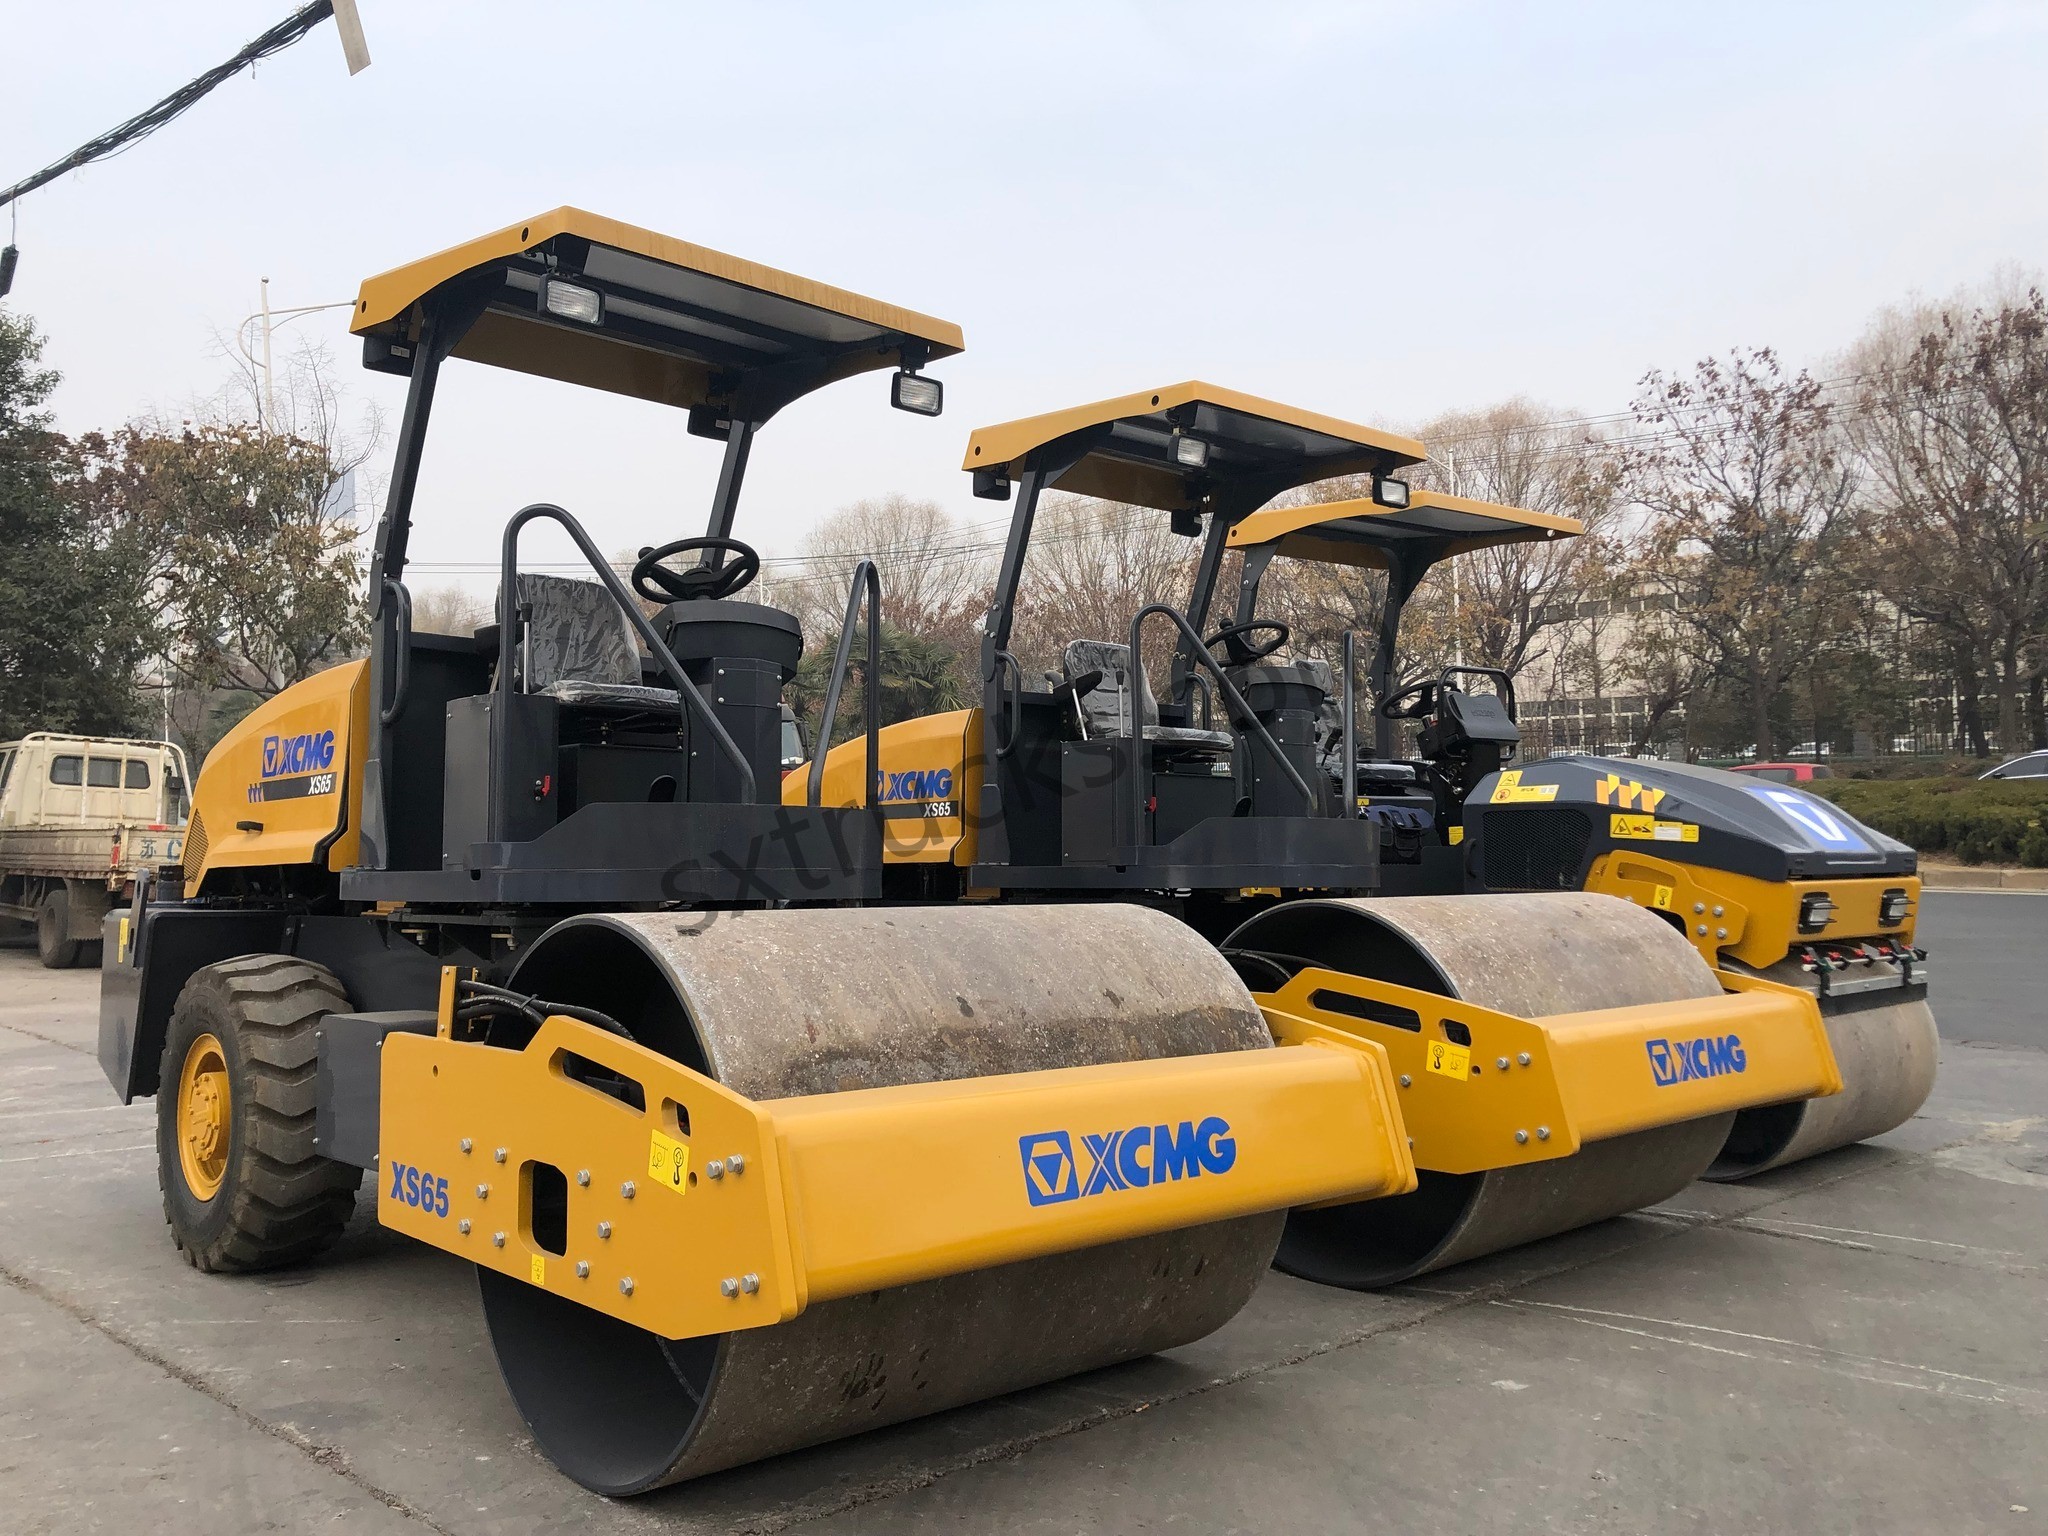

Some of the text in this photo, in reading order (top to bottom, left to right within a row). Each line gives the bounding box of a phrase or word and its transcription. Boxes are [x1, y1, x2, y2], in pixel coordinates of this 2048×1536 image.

[277, 730, 335, 775] XCMG
[308, 774, 332, 795] XS65
[885, 768, 953, 800] XCMG
[923, 802, 951, 817] XS65
[1673, 1035, 1746, 1082] XCMG
[1081, 1117, 1236, 1197] XCMG
[391, 1161, 449, 1218] XS65
